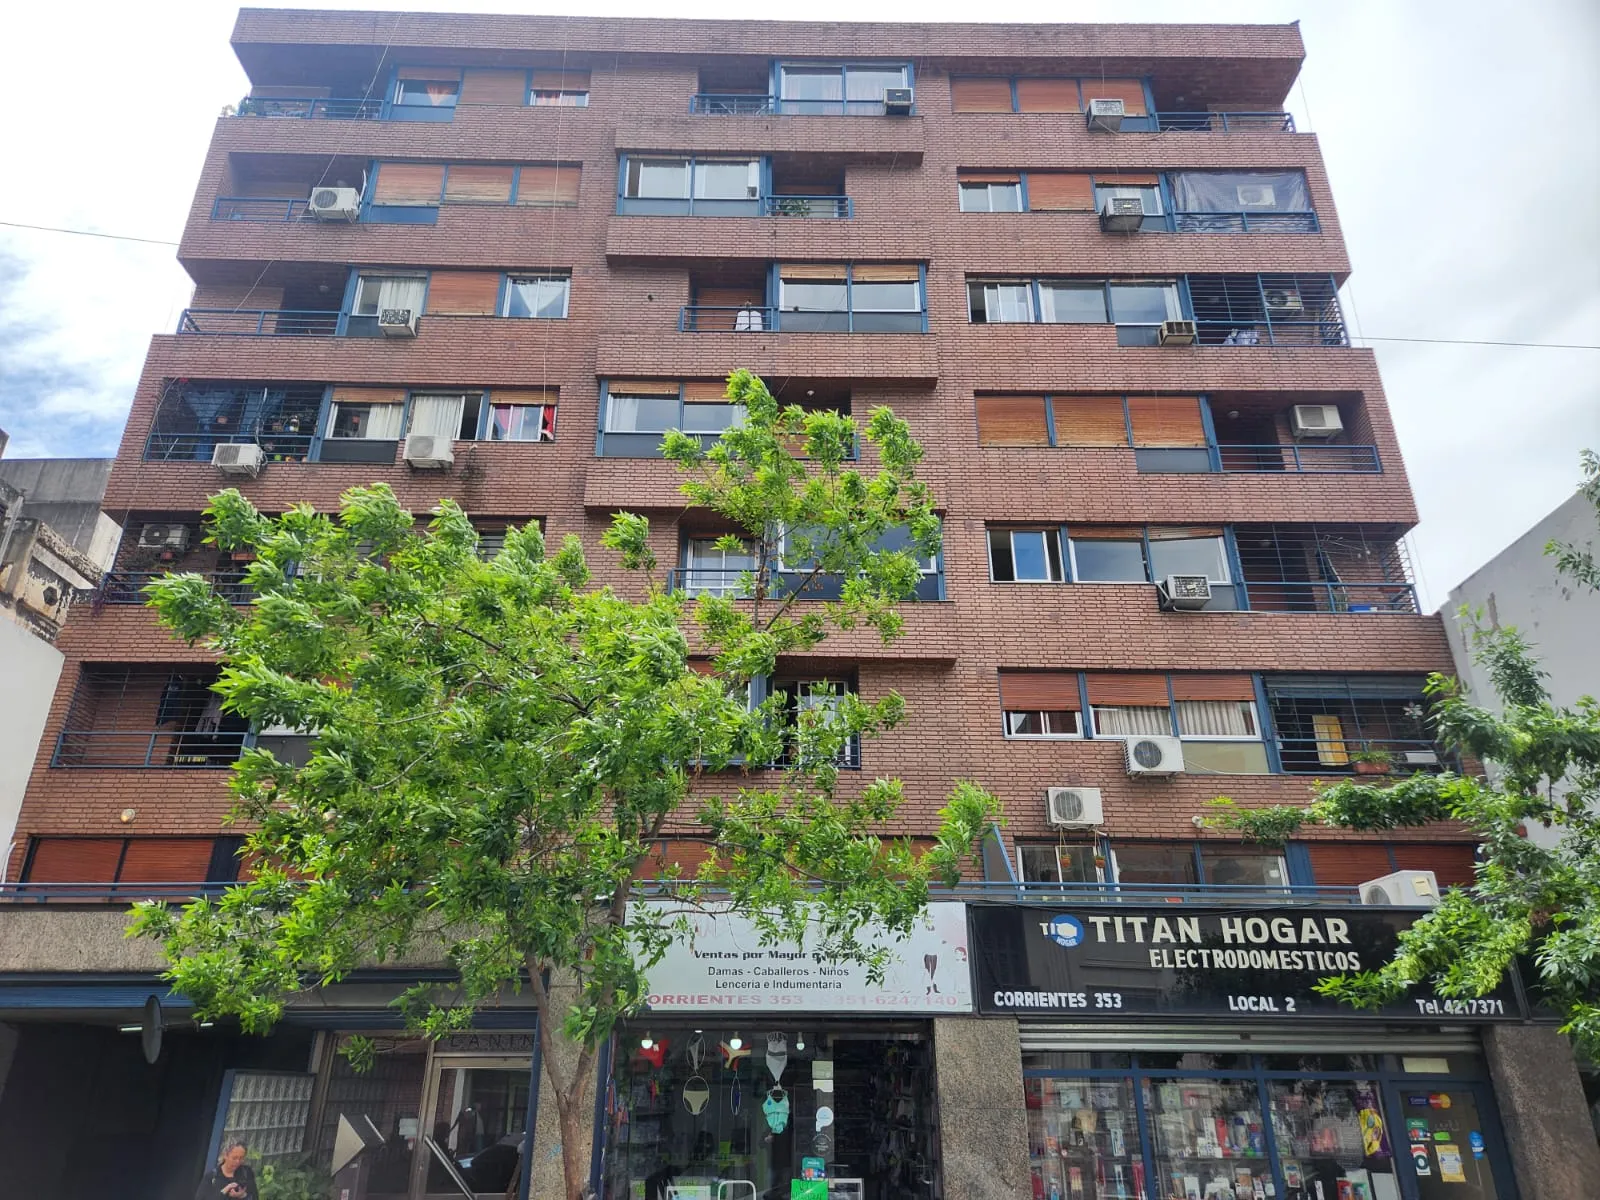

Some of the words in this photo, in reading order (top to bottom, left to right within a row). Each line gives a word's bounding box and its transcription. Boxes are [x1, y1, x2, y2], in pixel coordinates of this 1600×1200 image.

[1088, 916, 1201, 943] TITAN
[1220, 917, 1352, 944] HOGAR
[694, 950, 738, 959] Ventas
[743, 951, 764, 961] por
[768, 950, 807, 961] Mayor
[1149, 948, 1361, 971] ELECTRODOMESTICOS
[708, 966, 744, 976] Damas
[753, 966, 809, 976] Caballeros
[763, 981, 770, 989] e
[773, 979, 842, 989] Indumentaria
[647, 994, 761, 1005] ORRIENTES
[769, 995, 803, 1005] 353
[993, 991, 1087, 1008] CORRIENTES
[1094, 992, 1122, 1008] 353
[1228, 995, 1279, 1012] LOCAL
[1284, 996, 1297, 1012] 2
